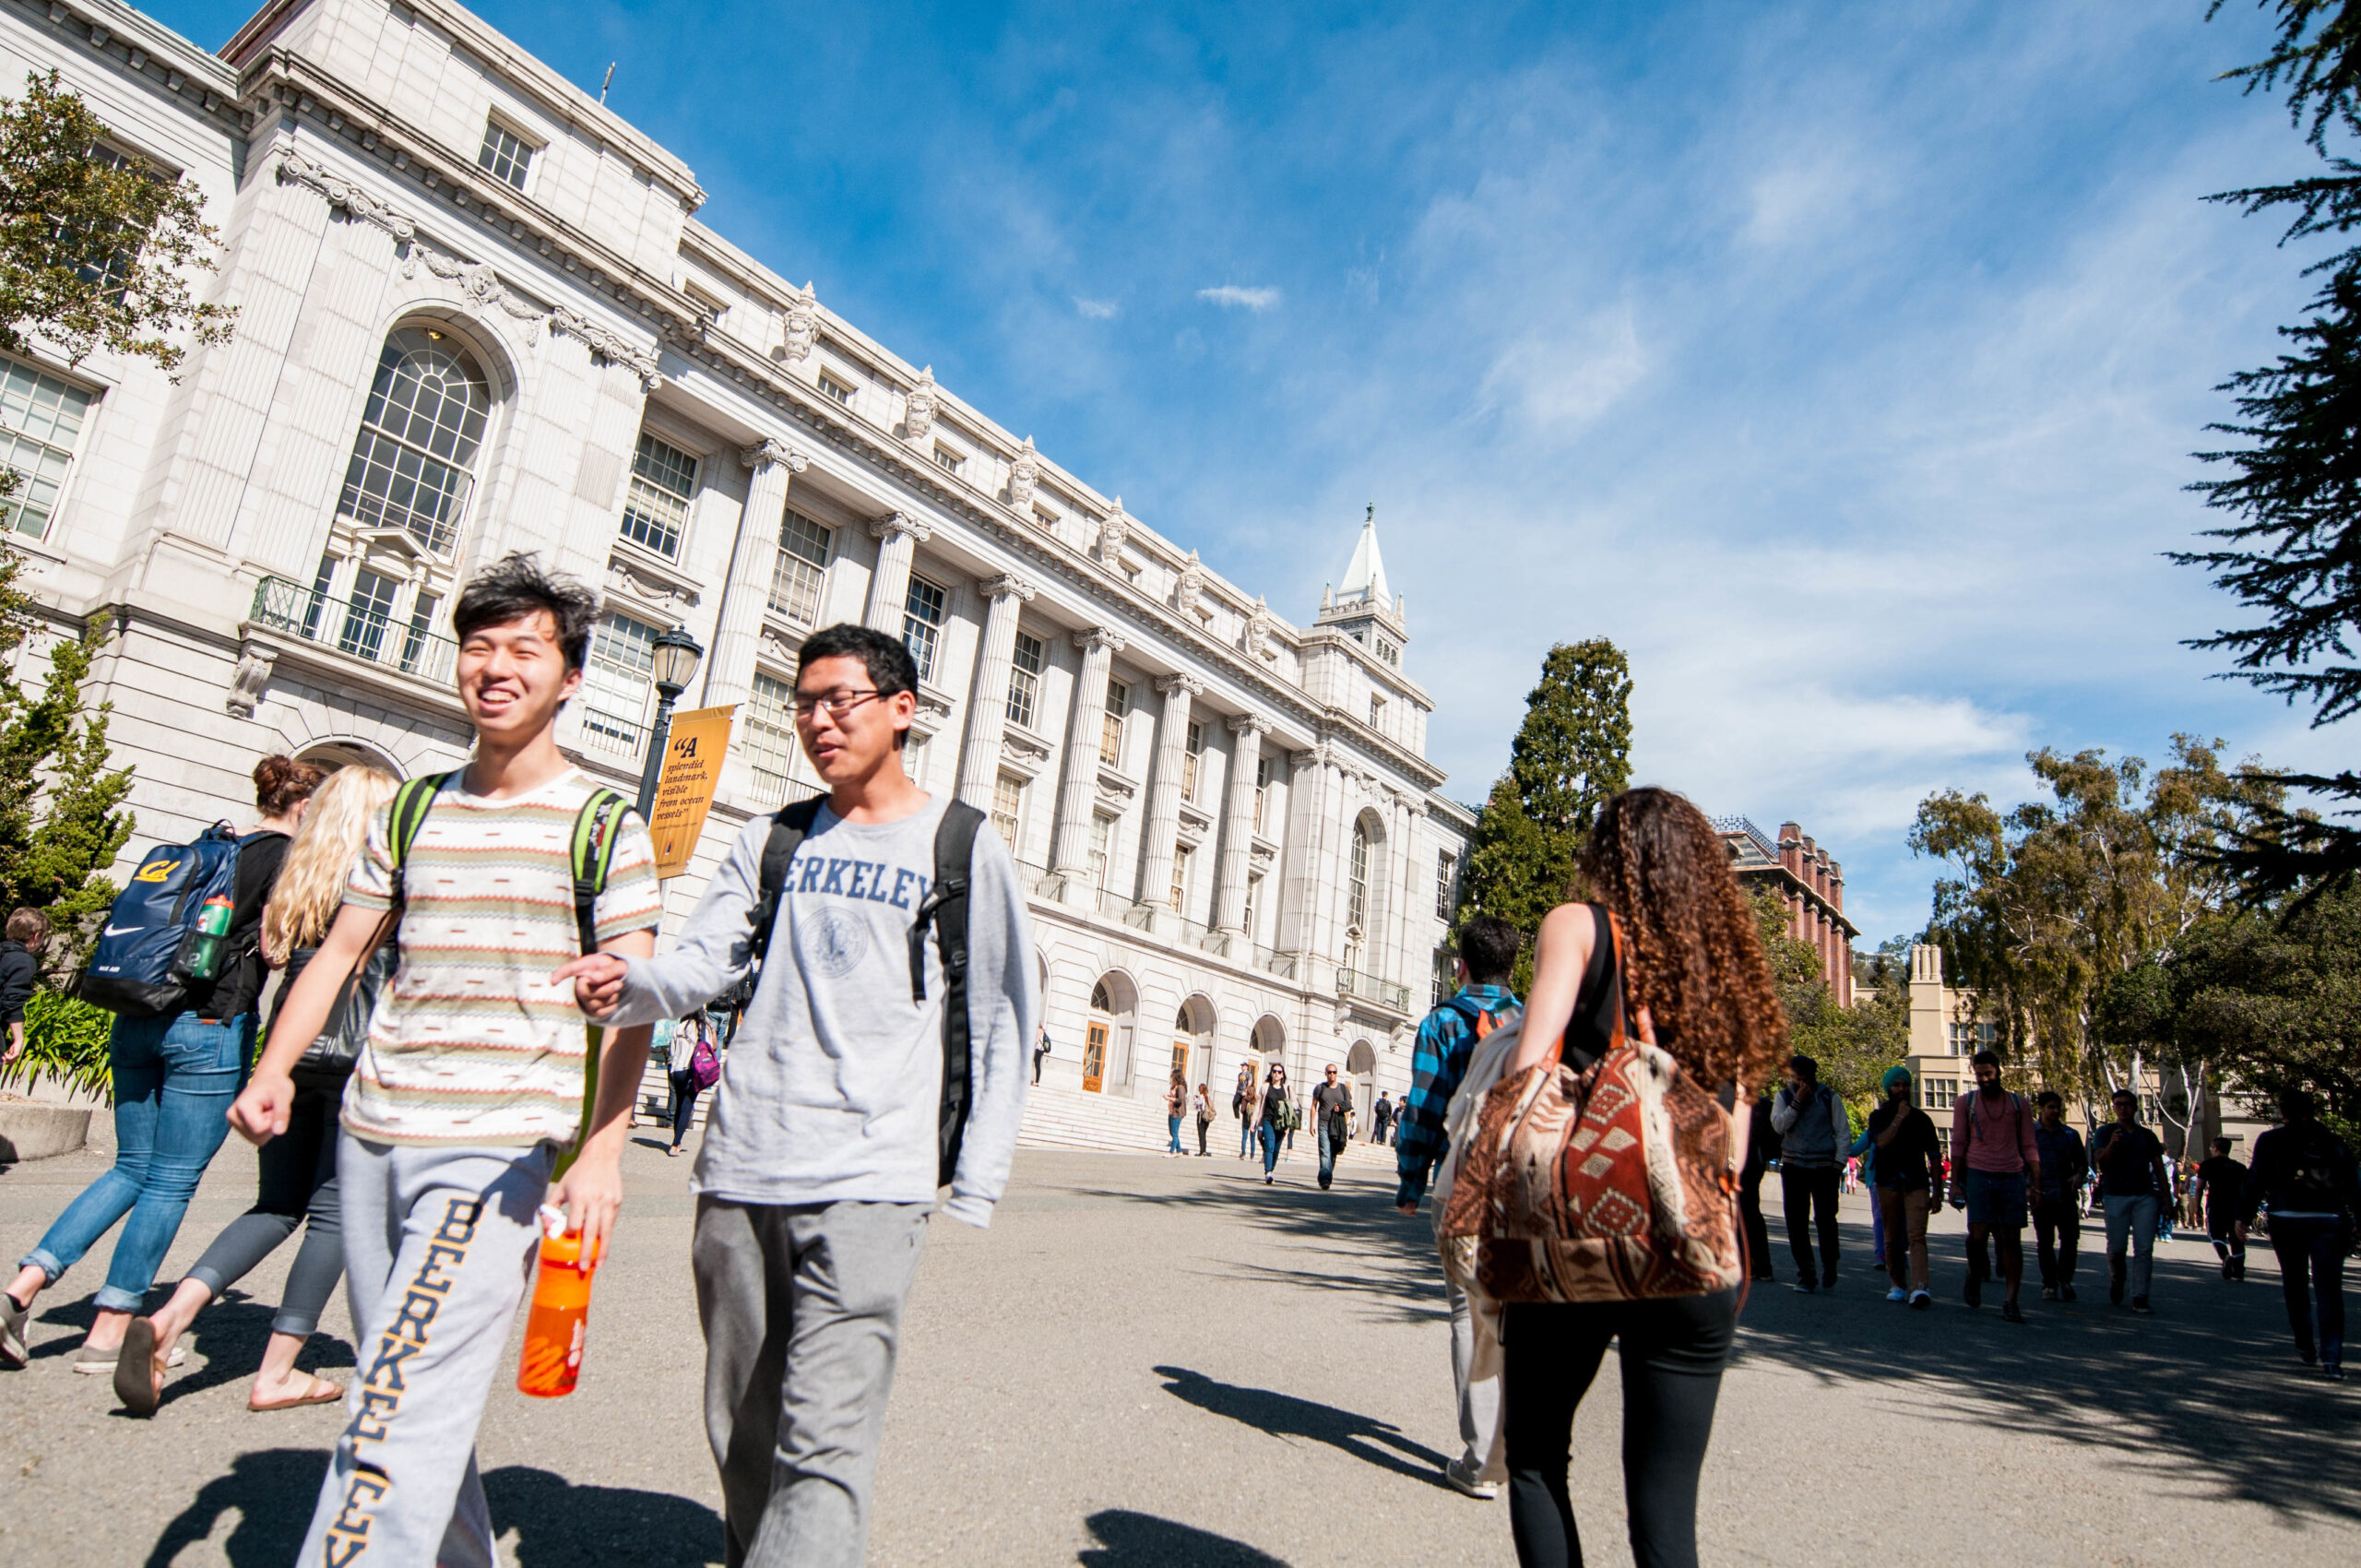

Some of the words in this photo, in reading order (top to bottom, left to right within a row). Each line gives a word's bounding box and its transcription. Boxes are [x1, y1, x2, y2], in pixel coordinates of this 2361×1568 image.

[667, 759, 705, 775] splendid
[664, 771, 708, 784] landmark,
[662, 784, 688, 796] visible
[657, 799, 678, 812] from
[680, 796, 705, 806] ocean
[133, 860, 181, 883] Cal
[782, 856, 934, 910] ERKELEY
